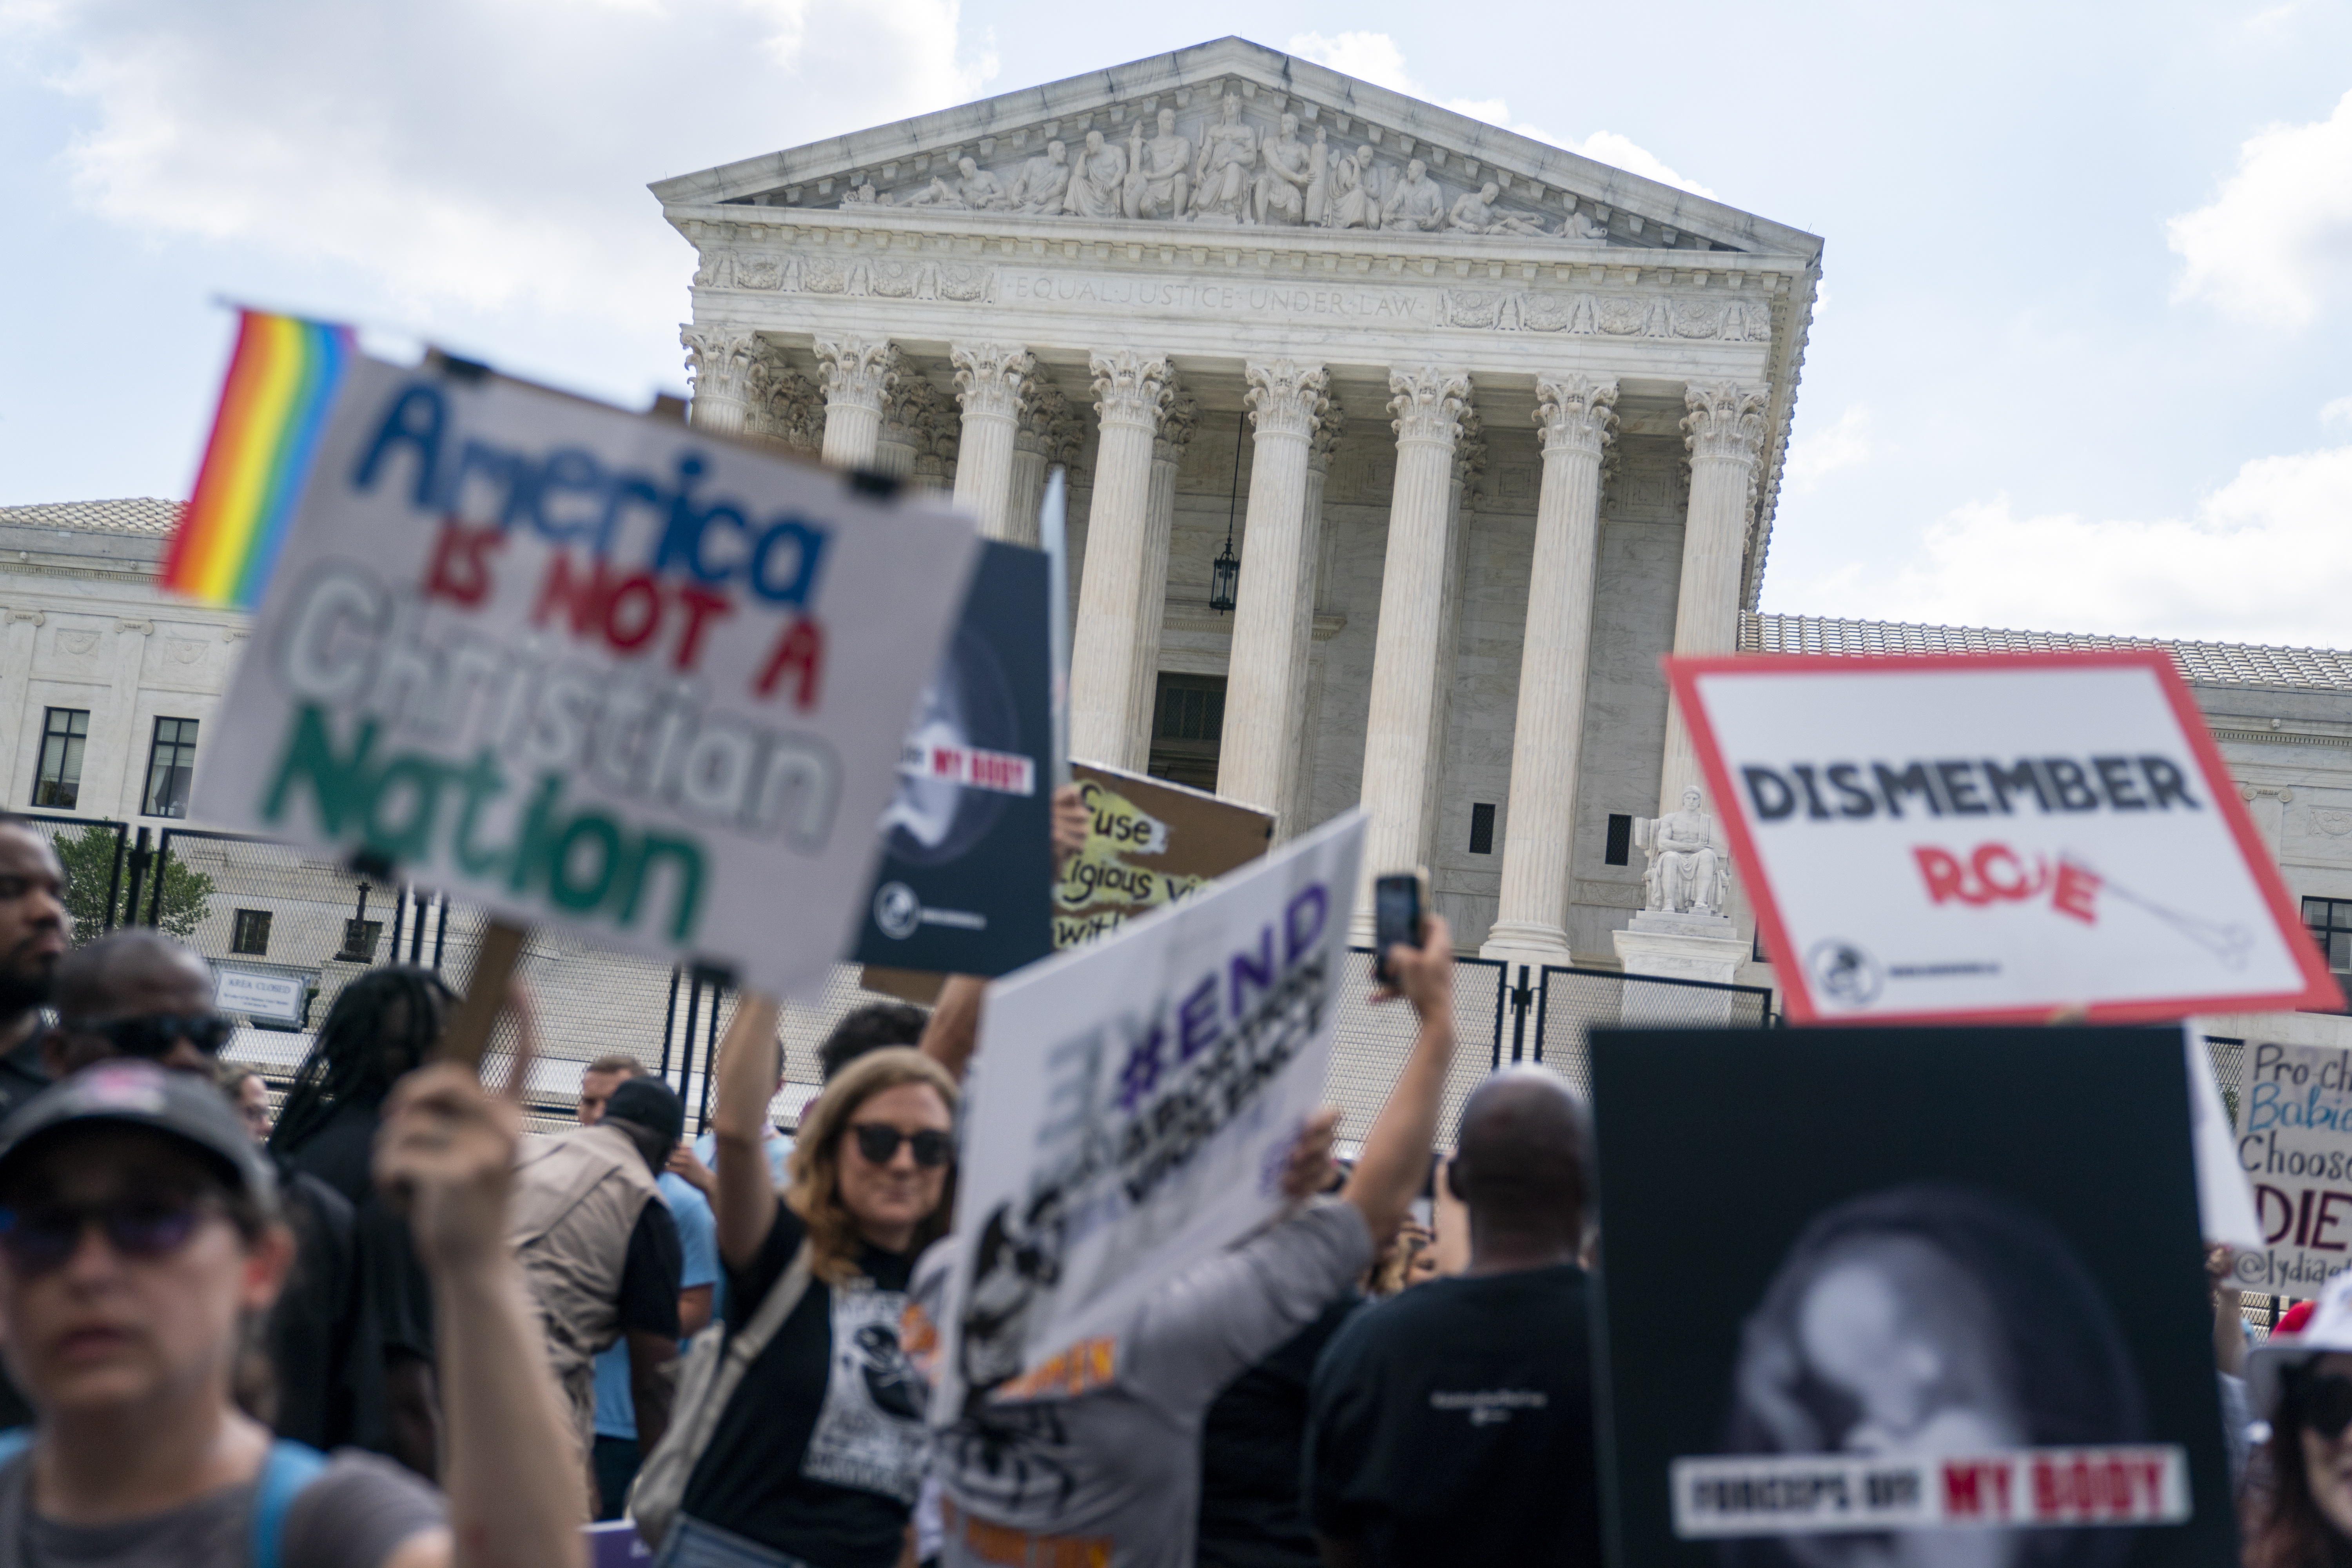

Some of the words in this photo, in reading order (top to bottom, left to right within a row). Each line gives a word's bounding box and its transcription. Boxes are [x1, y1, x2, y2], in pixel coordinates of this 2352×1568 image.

[1014, 276, 1112, 301] EQUAL
[1119, 282, 1234, 308] JUSTICE
[1249, 288, 1346, 314] UNDER
[1358, 294, 1418, 317] LAW
[350, 379, 828, 610] America
[423, 517, 510, 608] IS
[529, 543, 735, 670] NOT
[752, 613, 824, 711] A
[270, 556, 843, 857] Christian
[262, 700, 710, 947] Nation
[1740, 755, 2201, 822] DISMEMBER
[256, 982, 291, 994] CLOSED
[1117, 880, 1329, 1110] #END
[2255, 1183, 2352, 1251] DIE
[1940, 1458, 2014, 1523] MY
[2031, 1451, 2166, 1519] BODY
